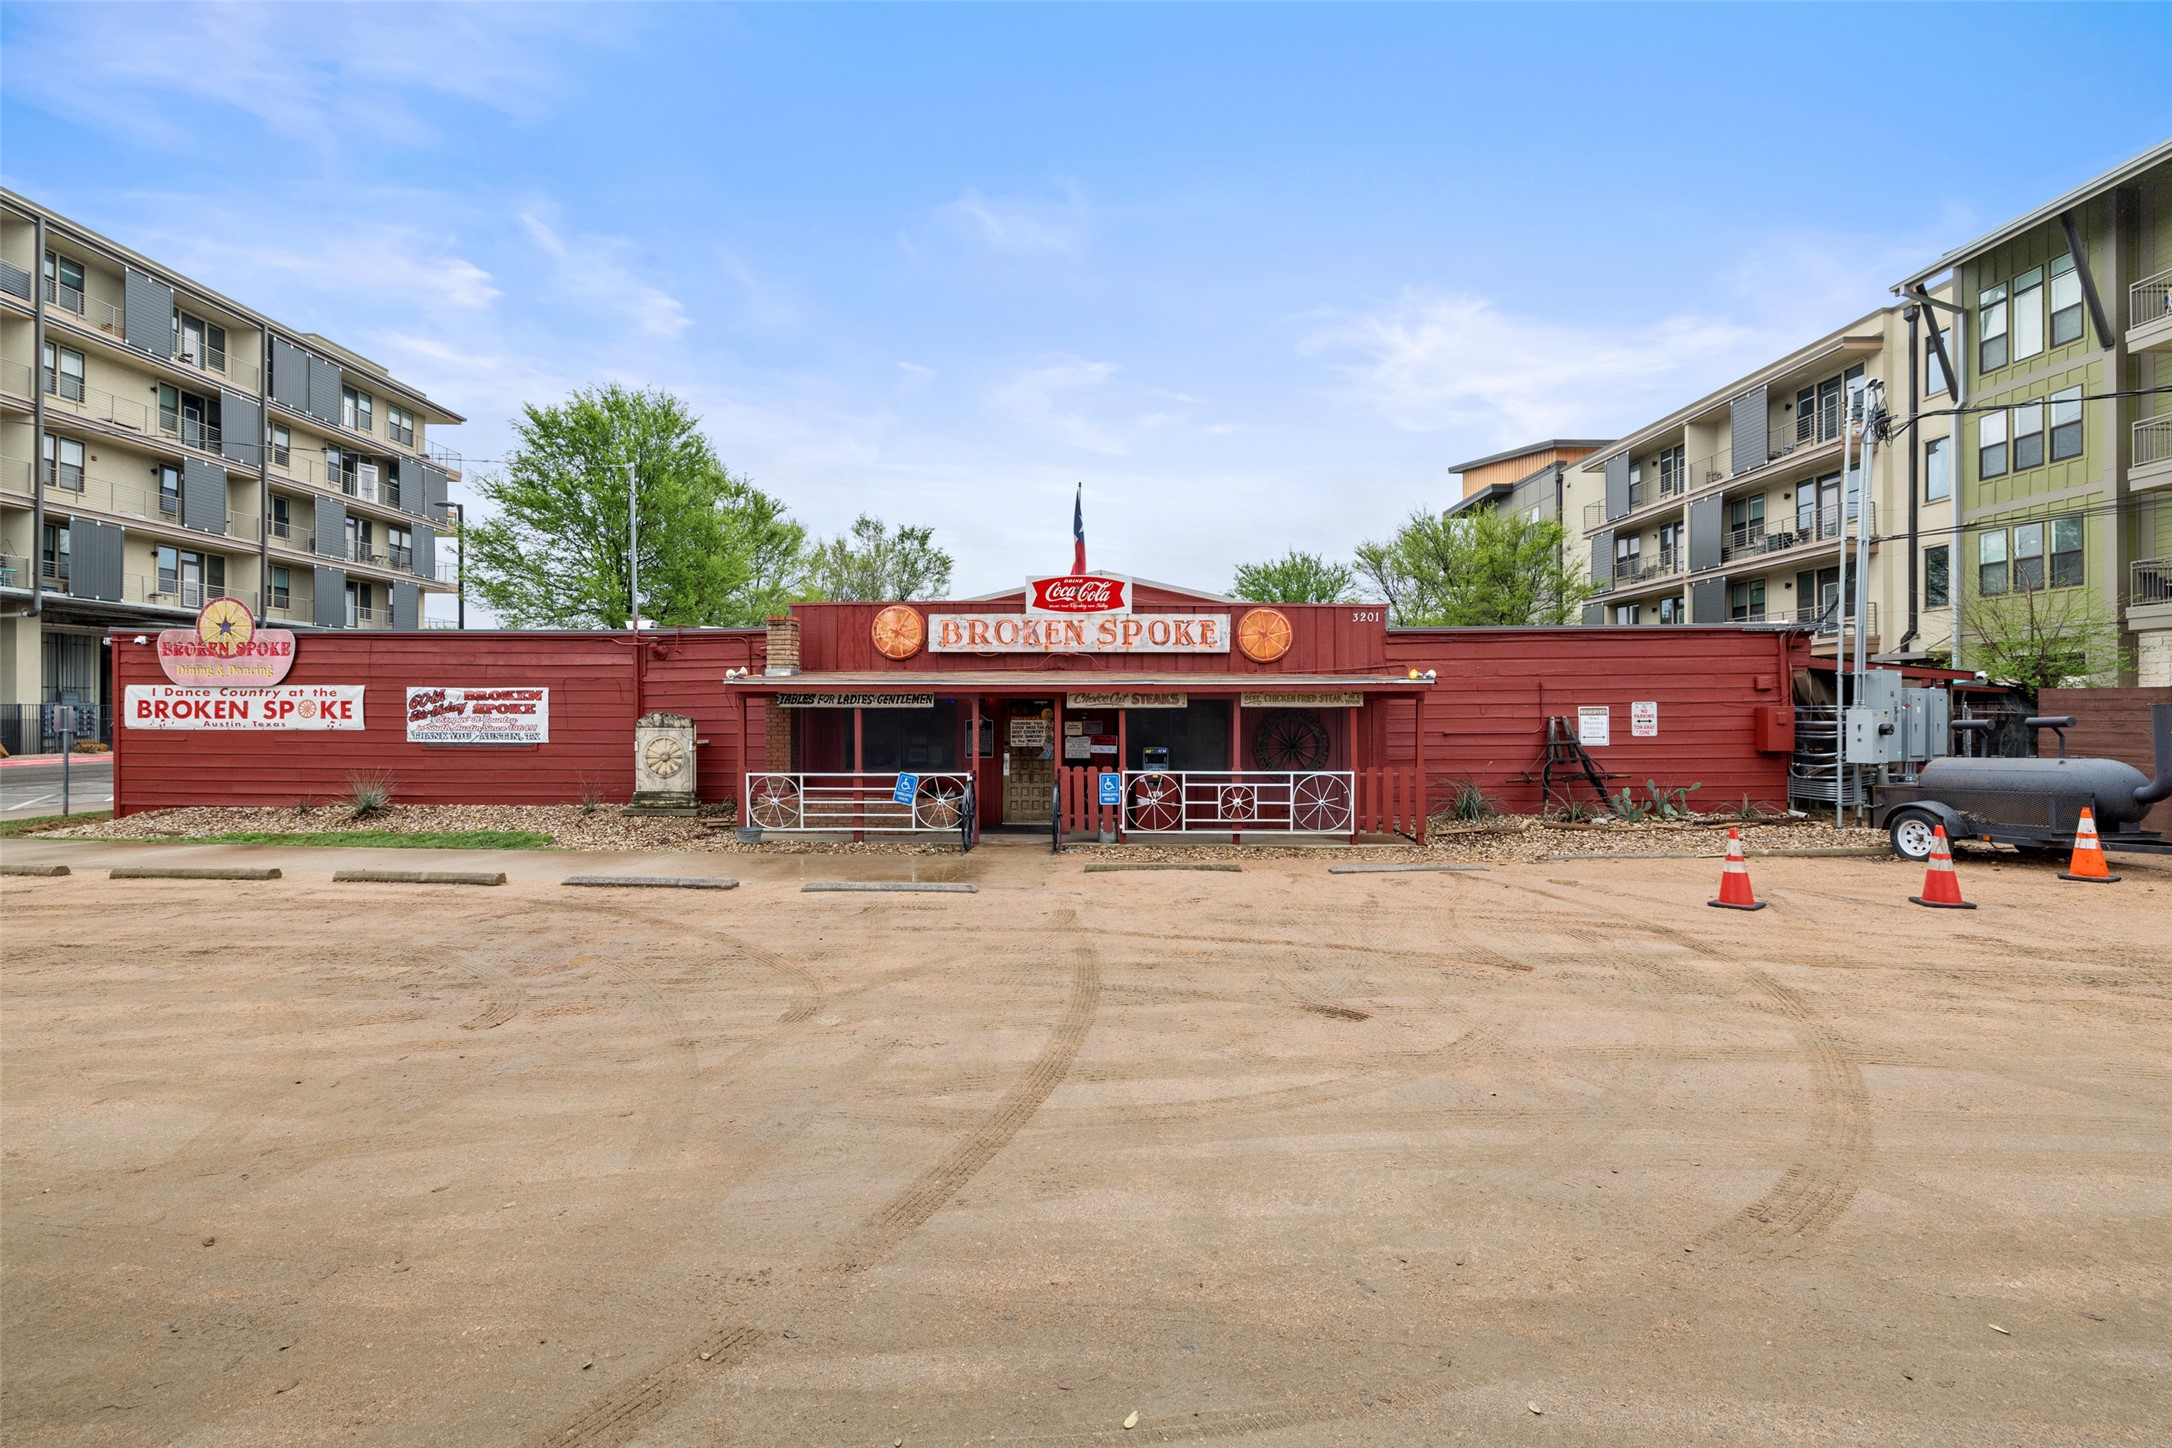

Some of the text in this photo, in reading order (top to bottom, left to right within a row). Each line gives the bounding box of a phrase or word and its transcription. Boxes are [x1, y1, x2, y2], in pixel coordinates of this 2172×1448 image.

[1352, 612, 1379, 622] 3201
[938, 619, 1218, 647] BROKEN SPOKE
[162, 641, 291, 657] BROKEN SPOKE
[176, 664, 273, 677] Dining & Dancing
[152, 687, 337, 700] I Dance Country at the
[409, 689, 446, 710] 60th
[463, 690, 543, 701] BROKEN
[778, 693, 816, 704] TABLES
[818, 694, 835, 704] FOR
[836, 693, 873, 704] LADIES
[877, 693, 933, 704] GENTLEMEN
[1074, 692, 1180, 705] Choice Cut STEAKS
[1264, 694, 1297, 703] CHICKEN
[1297, 694, 1316, 702] FRIED
[1319, 694, 1344, 703] STEAK
[137, 699, 353, 720] BROKEN SPOKE
[409, 701, 468, 722] Birthday
[472, 703, 536, 714] SPOKE
[203, 720, 286, 729] Austin, Texas
[412, 732, 541, 741] THANK YOU AUSTIN, TX
